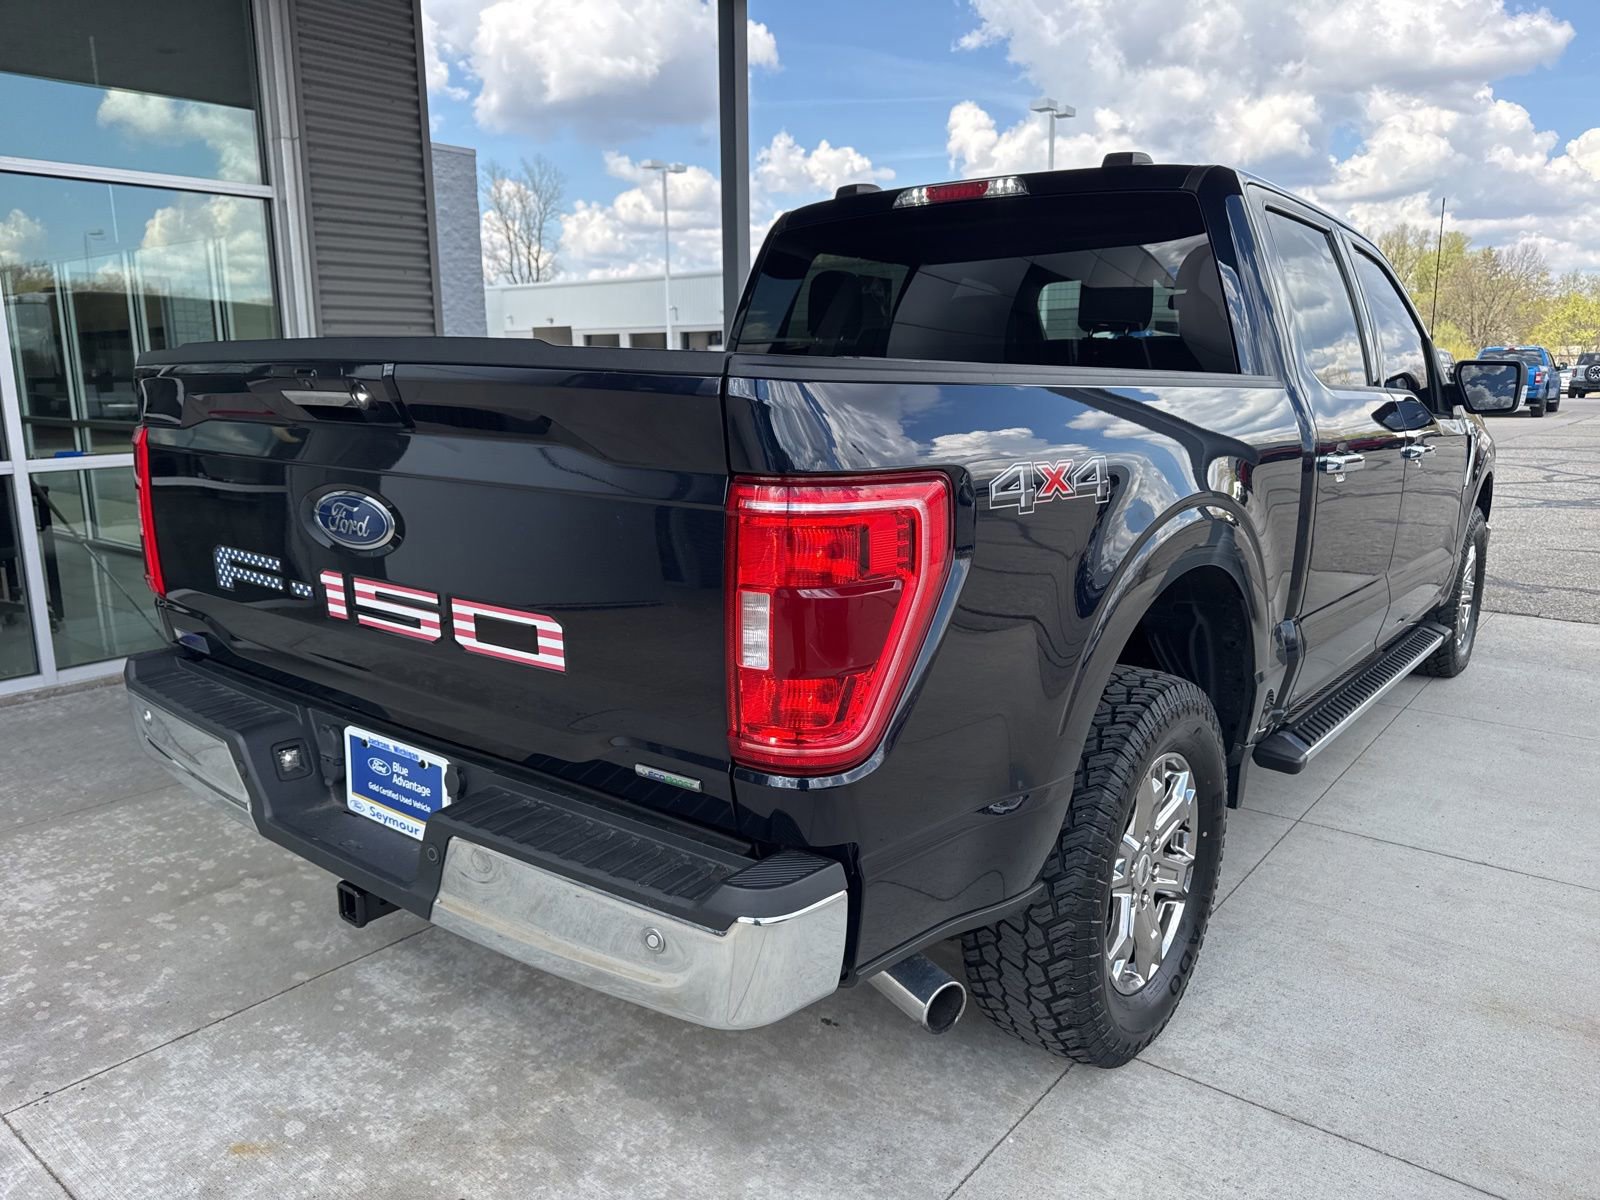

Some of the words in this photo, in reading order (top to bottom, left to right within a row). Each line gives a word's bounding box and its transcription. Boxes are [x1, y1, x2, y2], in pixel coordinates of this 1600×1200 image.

[328, 502, 371, 537] Ford
[213, 544, 568, 674] F-150
[392, 761, 409, 777] Blue
[368, 781, 379, 793] Gold
[379, 786, 399, 801] Certified
[399, 795, 412, 806] Used
[412, 799, 431, 813] Vehicle
[392, 774, 431, 797] Advantage
[369, 806, 420, 835] Seymour
